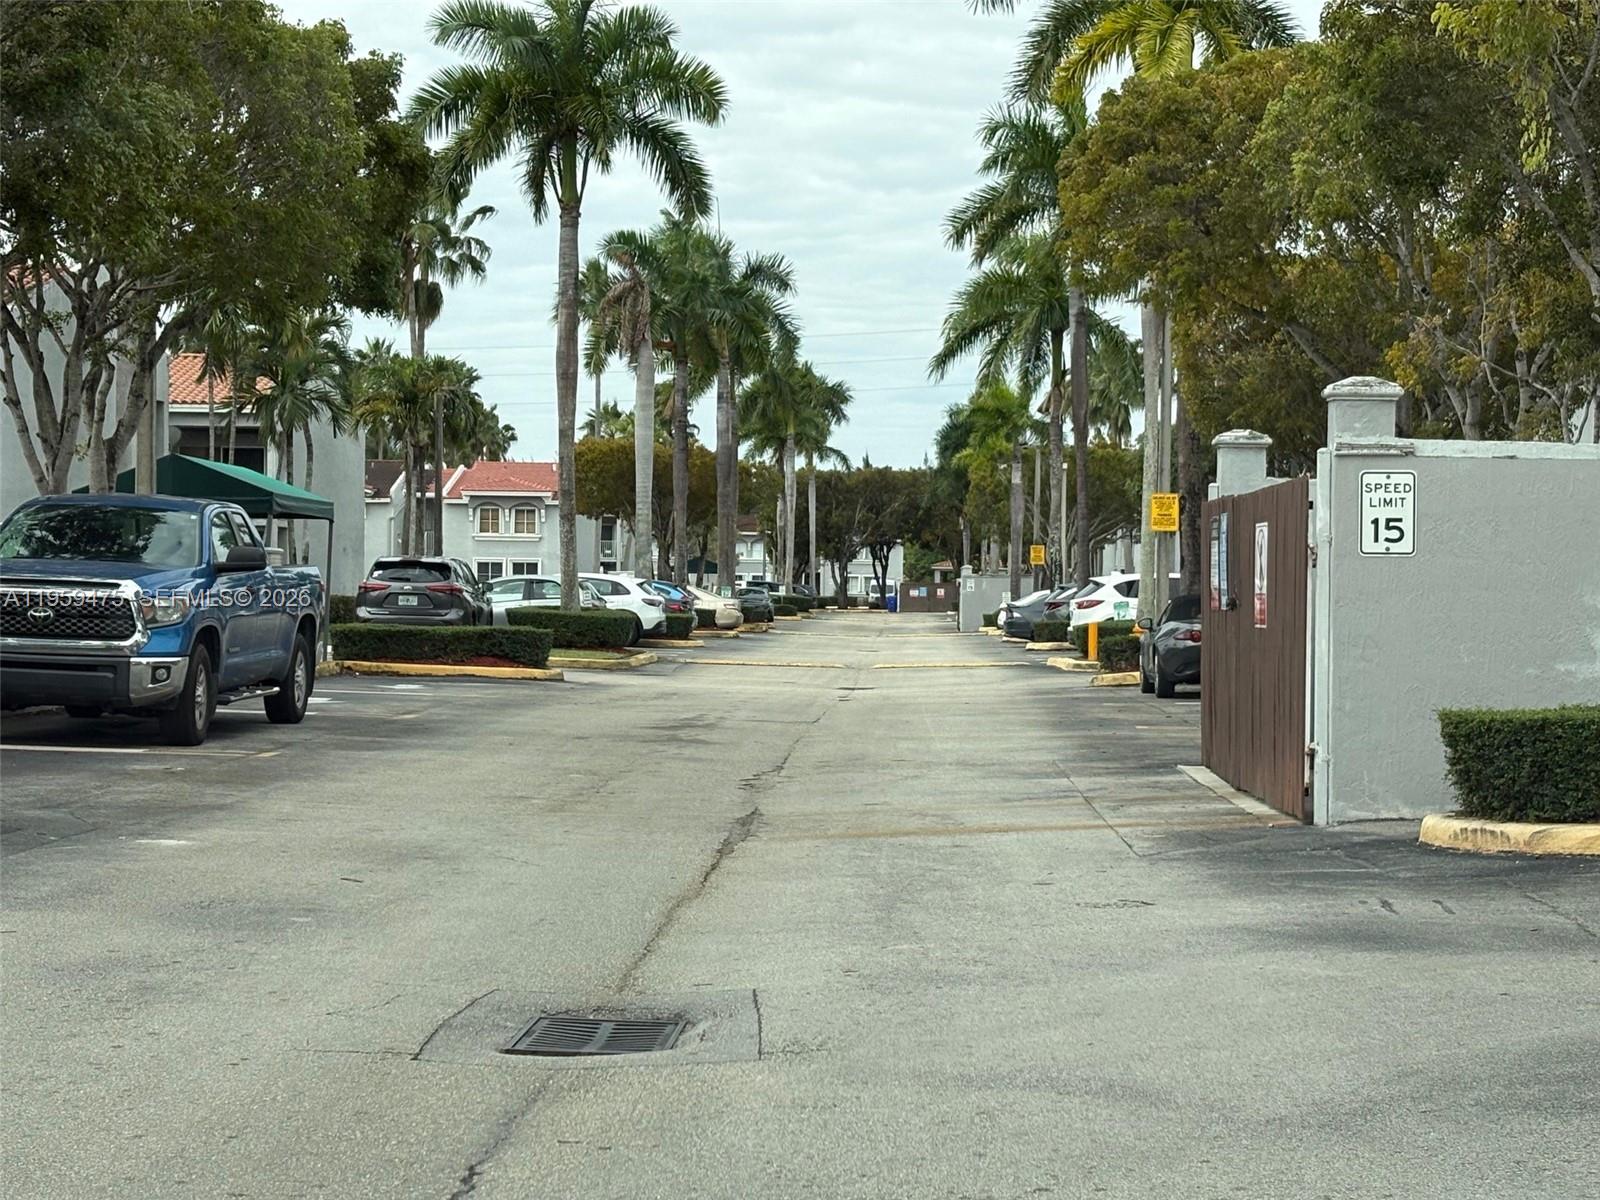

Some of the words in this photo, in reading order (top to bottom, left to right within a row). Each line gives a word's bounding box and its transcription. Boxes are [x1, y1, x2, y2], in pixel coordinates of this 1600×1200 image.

[1364, 483, 1411, 493] SPEED
[1369, 497, 1406, 508] LIMIT
[1370, 517, 1405, 543] 15
